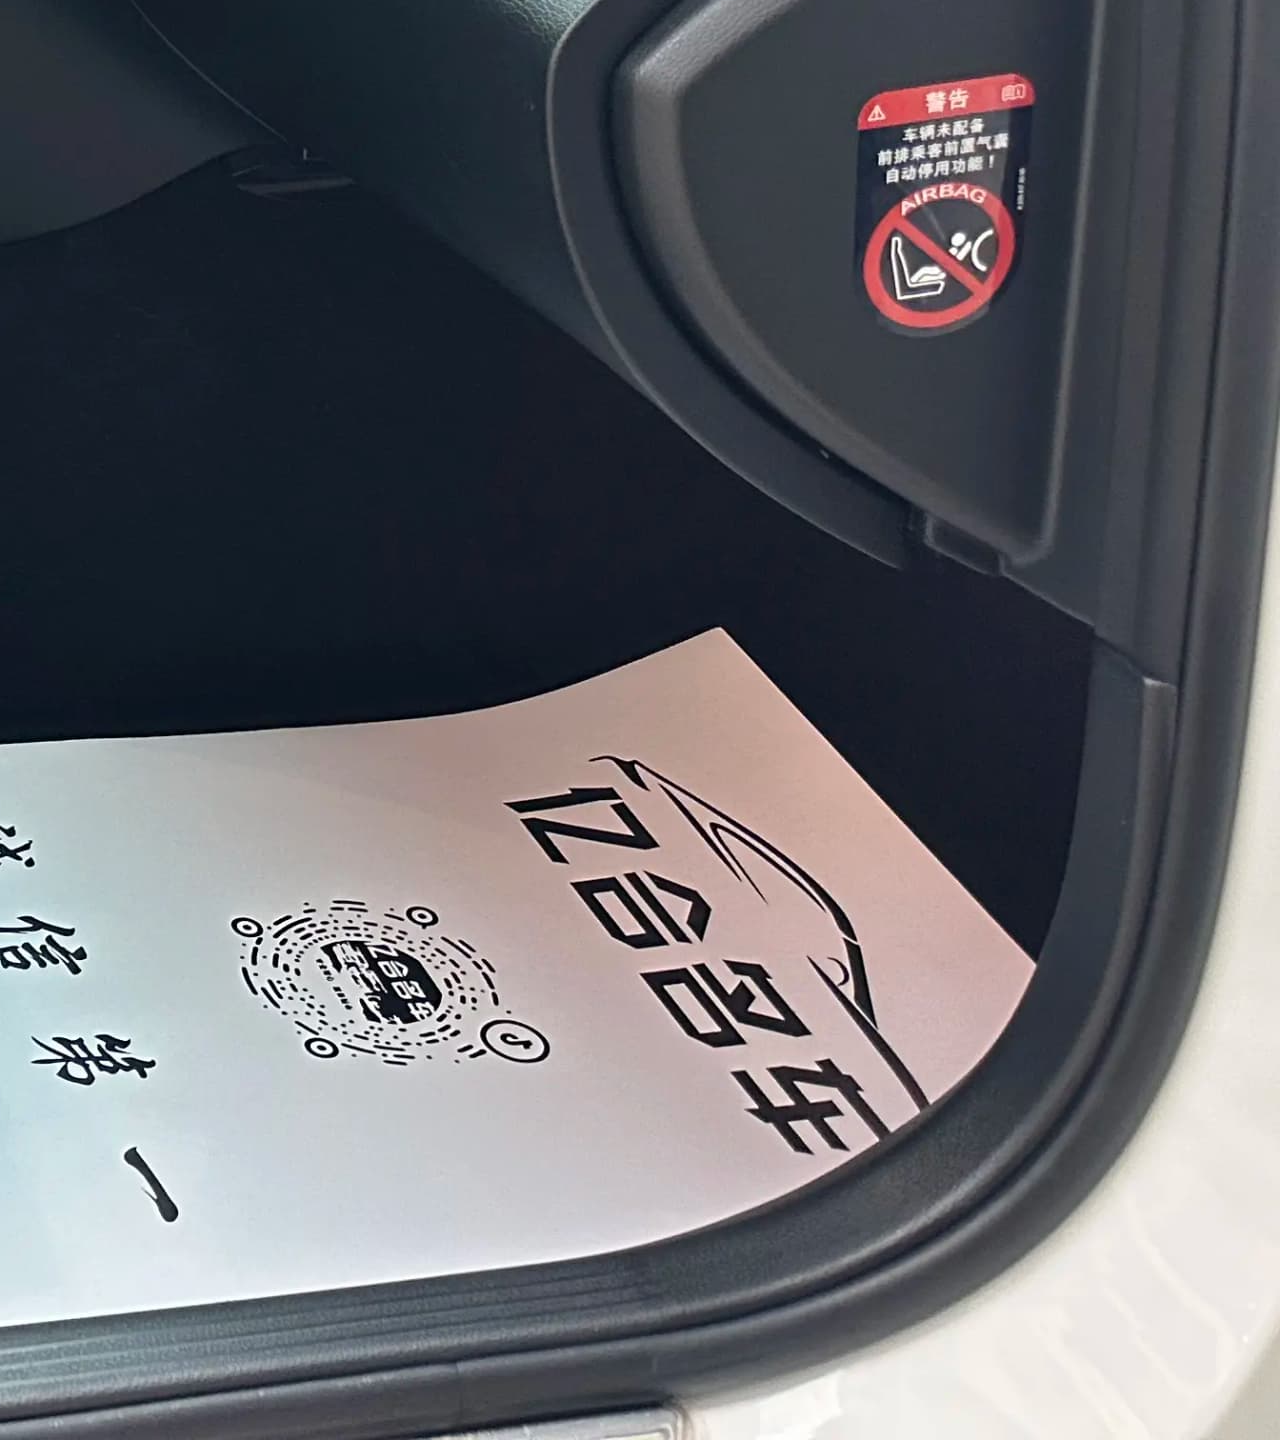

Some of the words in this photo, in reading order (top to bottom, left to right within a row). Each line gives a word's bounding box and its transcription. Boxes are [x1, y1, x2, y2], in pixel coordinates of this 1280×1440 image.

[925, 89, 970, 113] 警告
[902, 118, 985, 142] 车辆未配备
[900, 184, 987, 216] AIRBAG
[504, 784, 884, 1155] 亿合名车
